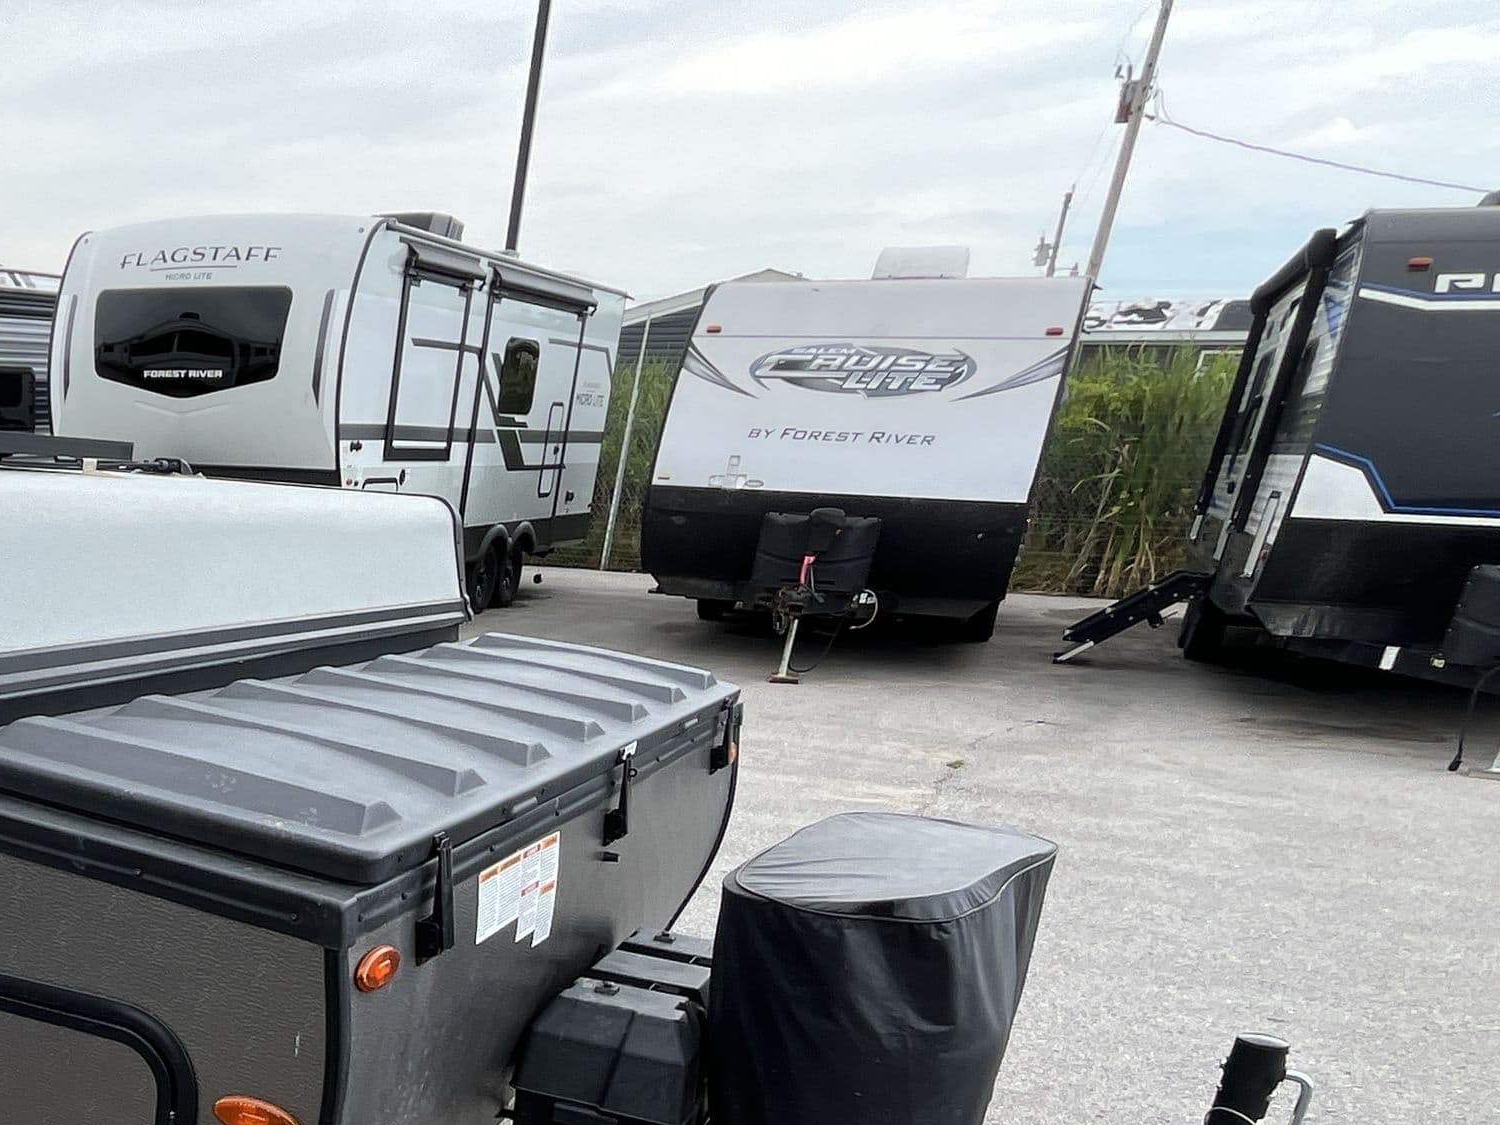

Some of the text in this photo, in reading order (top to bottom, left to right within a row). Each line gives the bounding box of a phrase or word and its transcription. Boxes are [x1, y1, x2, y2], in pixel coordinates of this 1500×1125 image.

[120, 246, 282, 270] FLAGSTAFF
[165, 272, 213, 281] MICRO LITE
[1434, 273, 1500, 293] P
[143, 370, 223, 378] FOREST RIVER
[754, 353, 967, 378] CRUISE
[842, 371, 951, 391] LITE
[748, 428, 936, 446] BY FOREST RIVER
